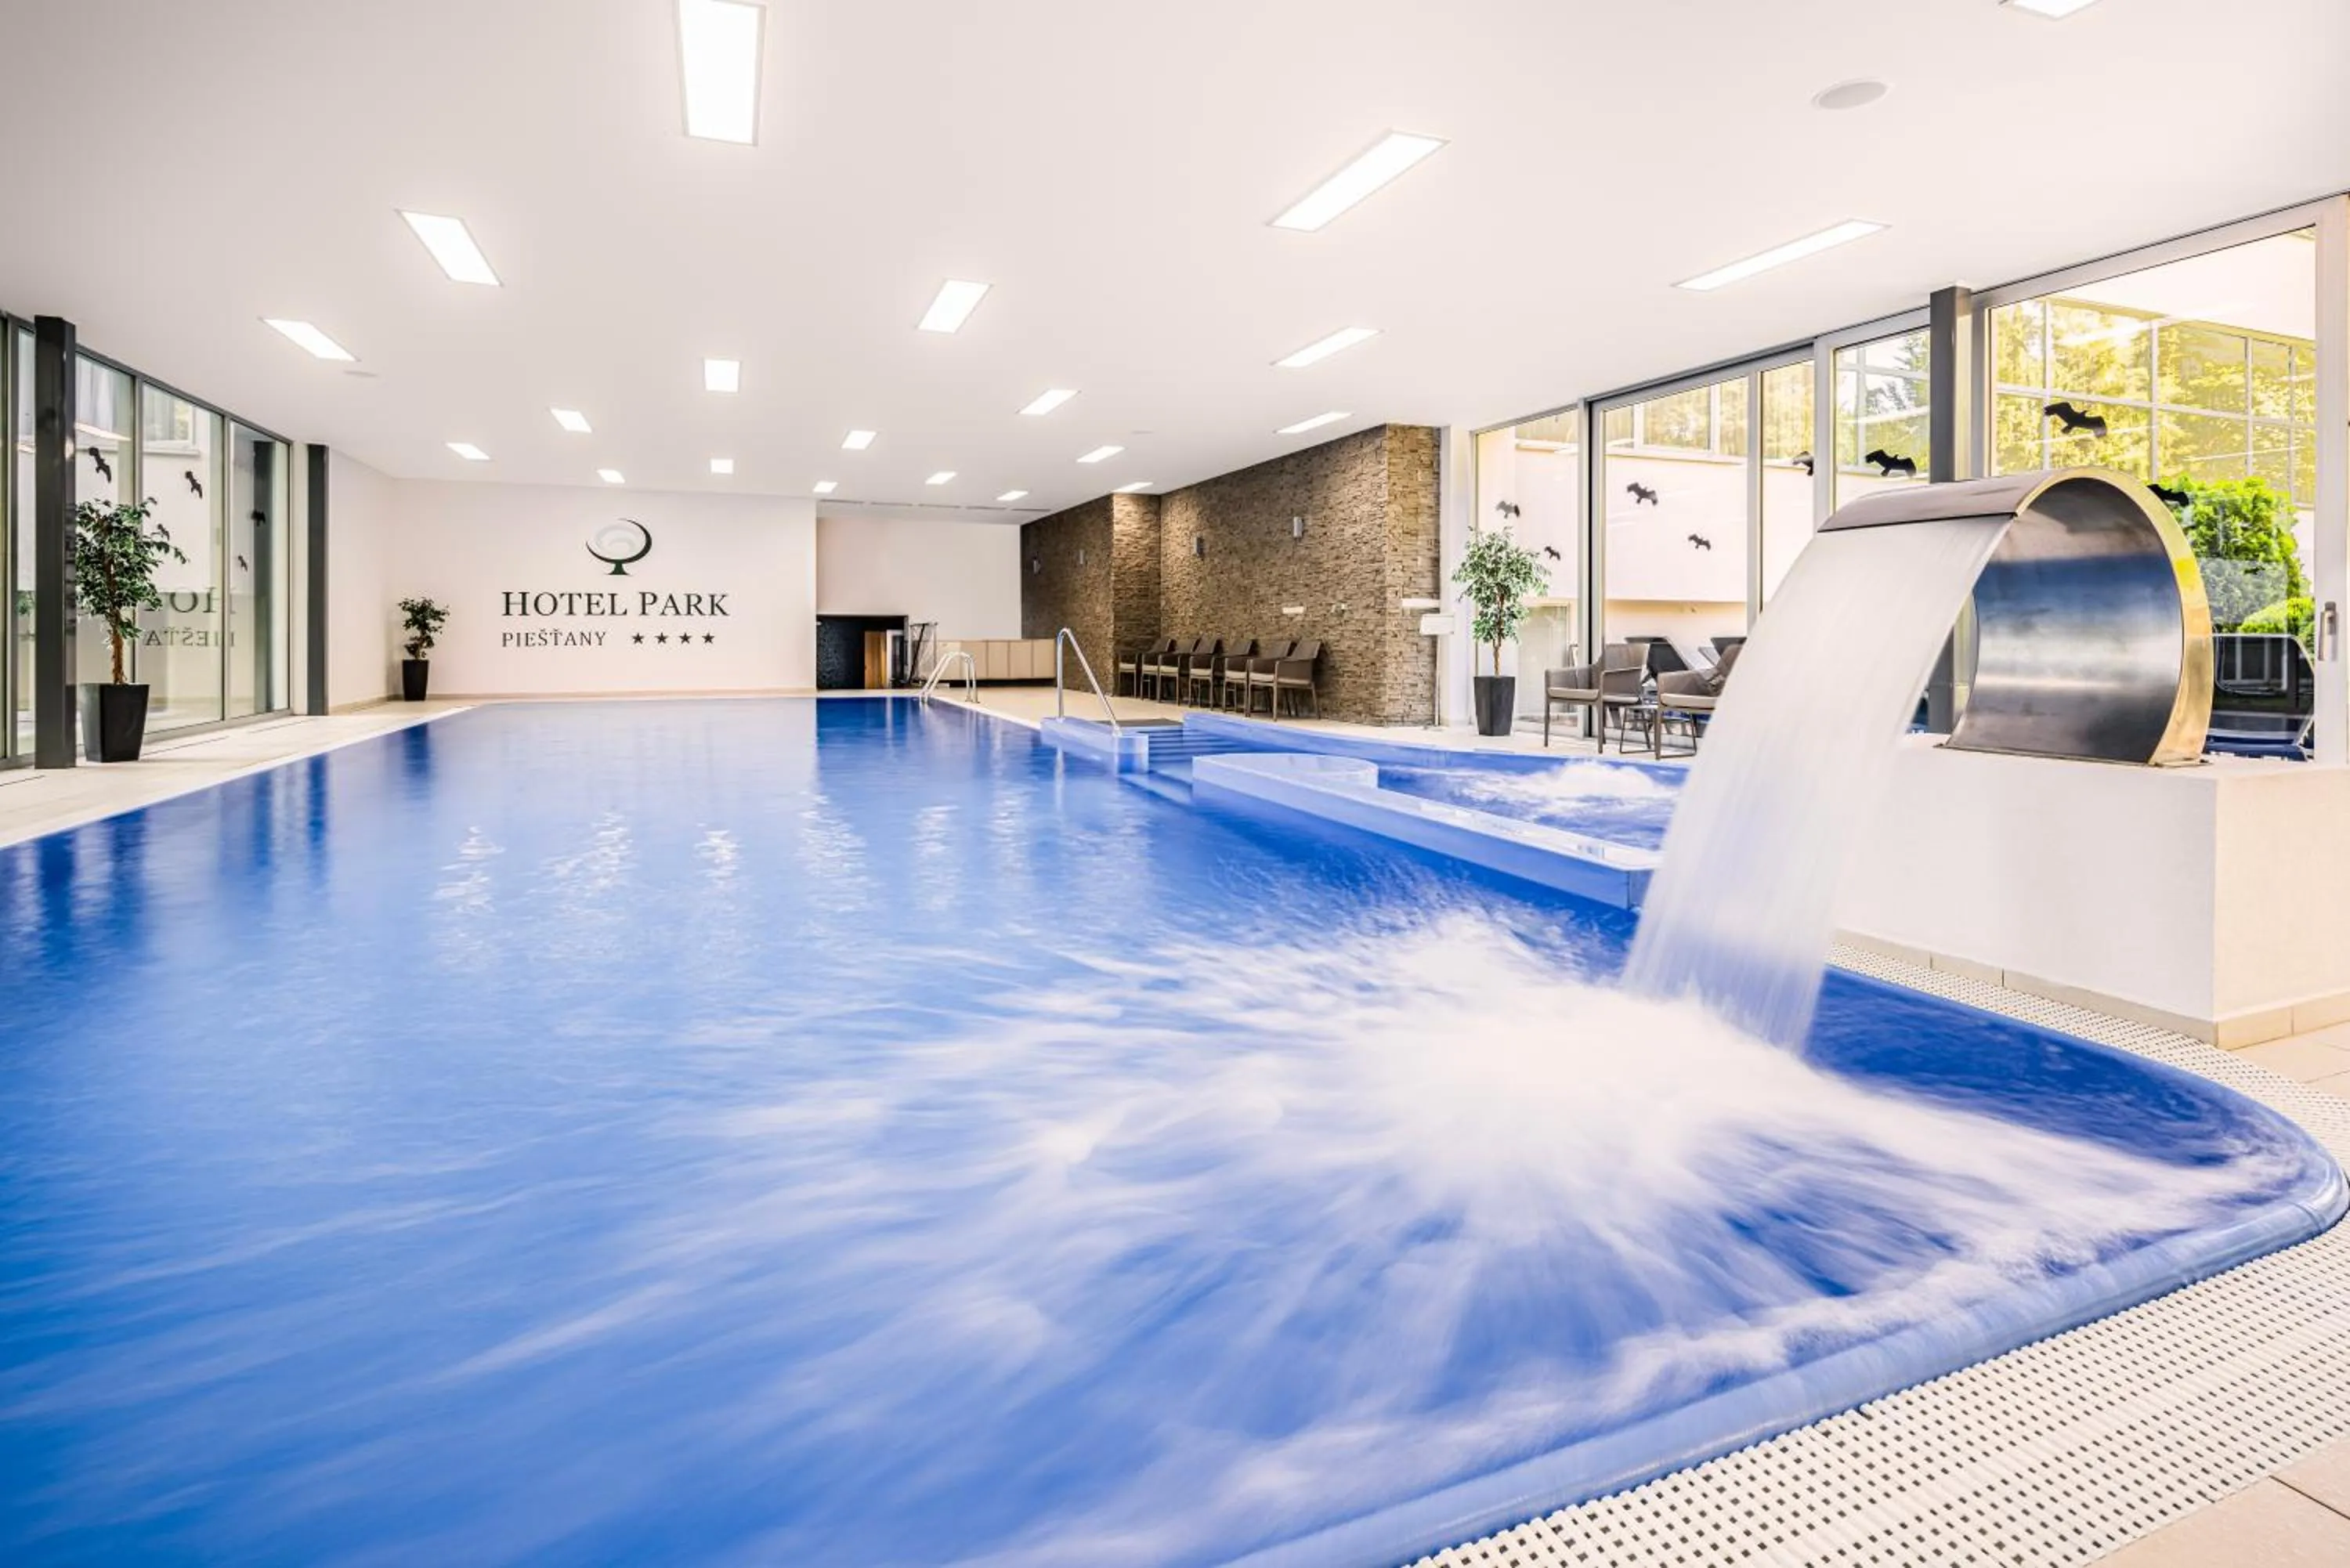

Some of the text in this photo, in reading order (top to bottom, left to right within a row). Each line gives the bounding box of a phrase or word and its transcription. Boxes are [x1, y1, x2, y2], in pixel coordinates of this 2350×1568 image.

[501, 591, 731, 616] HOTEL PARK
[501, 627, 606, 648] PIEŠŤANY
